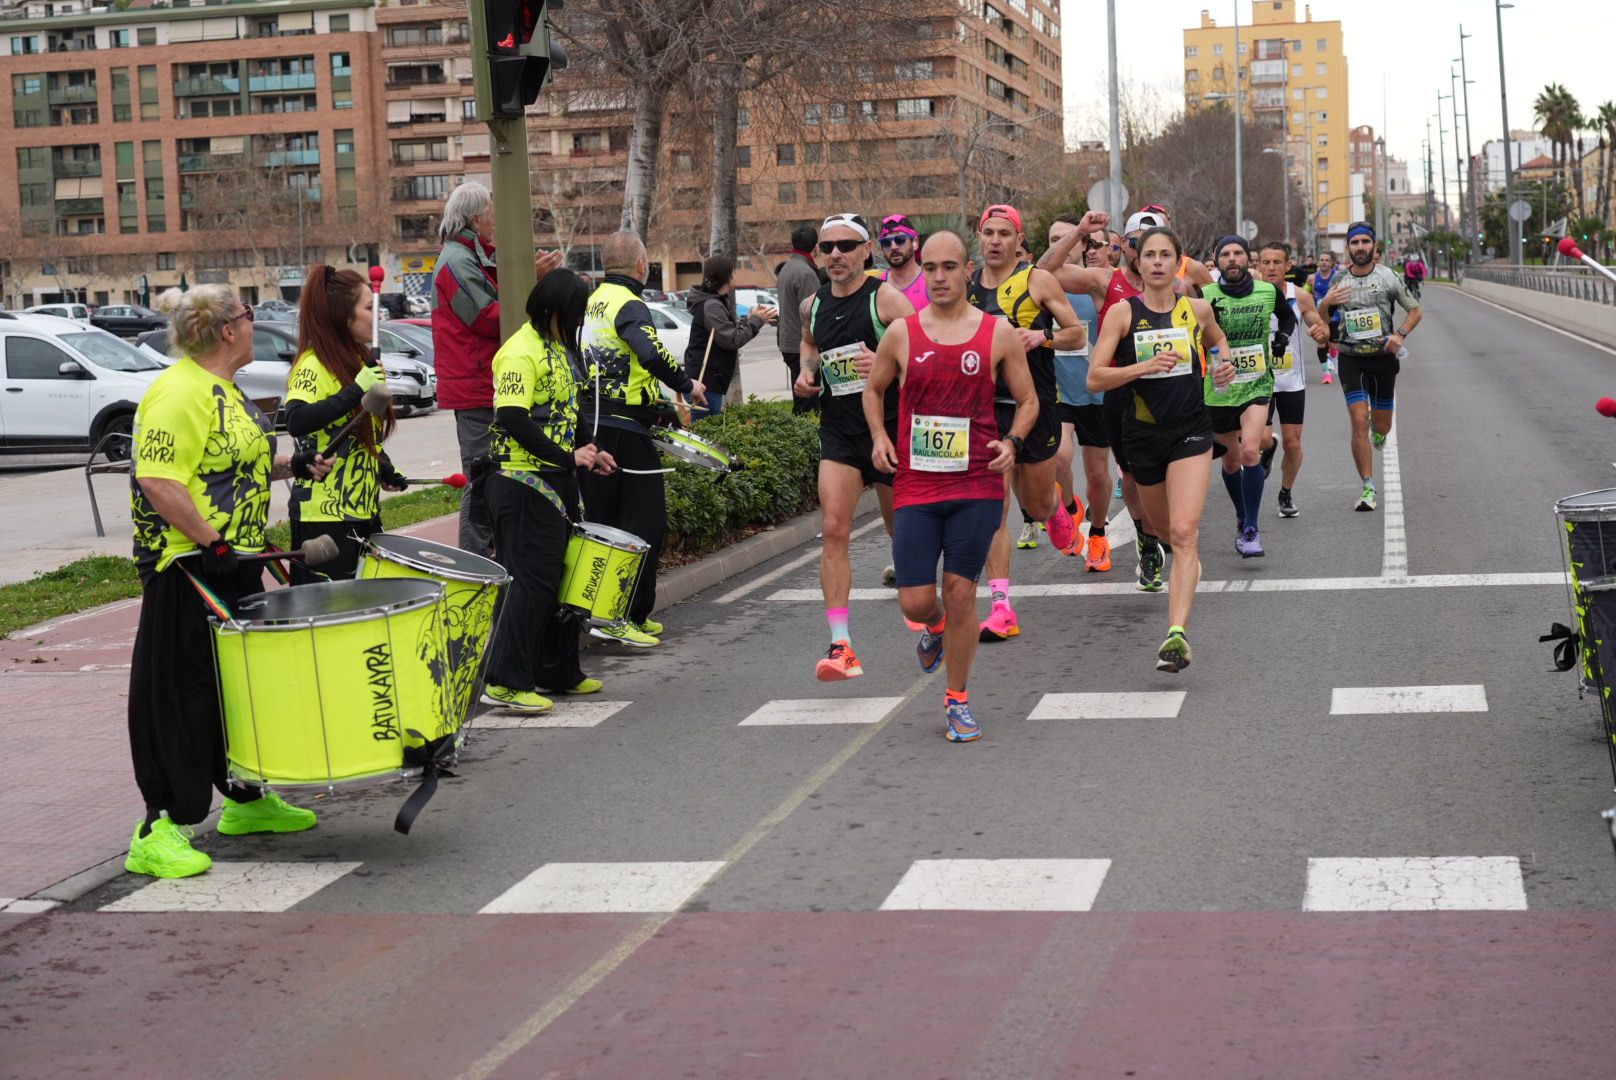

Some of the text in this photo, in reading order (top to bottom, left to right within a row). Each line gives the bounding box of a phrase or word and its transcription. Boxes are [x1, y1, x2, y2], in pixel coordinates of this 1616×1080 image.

[1353, 315, 1374, 329] 186
[1231, 355, 1257, 369] 455
[145, 428, 175, 447] BATU
[922, 430, 956, 450] 167
[140, 442, 175, 465] KAYRA
[582, 556, 606, 602] BATUKAYRA
[362, 643, 401, 742] BATUKAYRA
